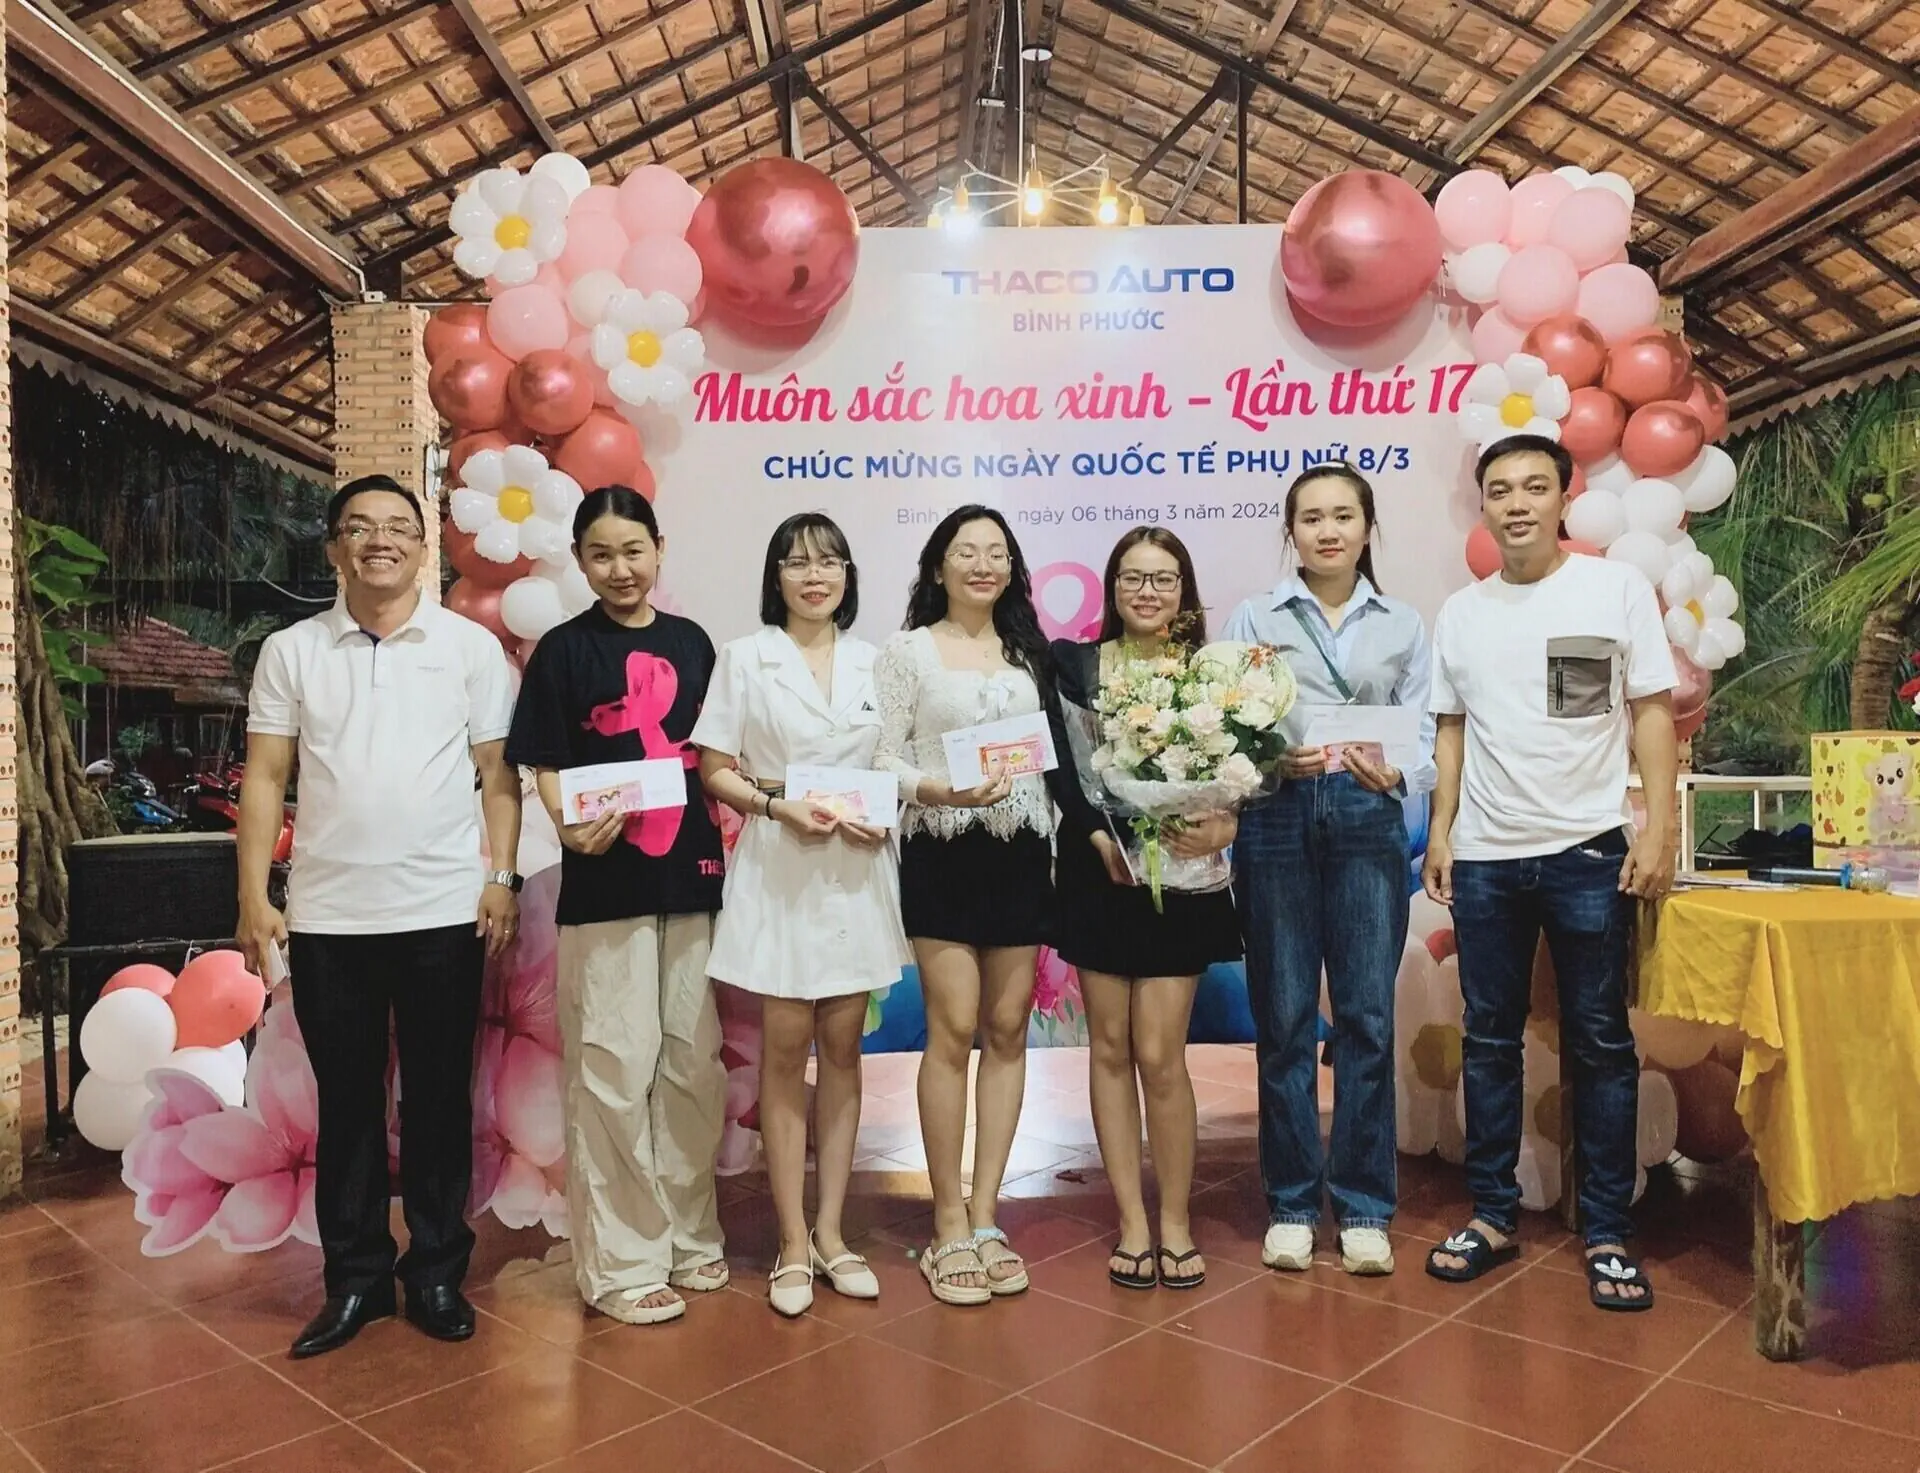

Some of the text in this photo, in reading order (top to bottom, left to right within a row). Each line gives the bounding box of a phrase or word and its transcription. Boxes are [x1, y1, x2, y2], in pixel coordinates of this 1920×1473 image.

[941, 263, 1235, 295] THACO AUTO
[1013, 307, 1165, 333] BÌNH PHƯỚC
[693, 371, 837, 423] Muôn
[847, 361, 934, 422] sắc
[944, 372, 1043, 422] hoa
[1055, 371, 1172, 421] xinh
[1225, 358, 1319, 433] Lần
[1328, 364, 1416, 416] thứ
[1428, 363, 1478, 415] 17
[764, 449, 854, 480] CHÚC
[865, 448, 963, 479] MỪNG
[974, 448, 1061, 478] NGÀY
[1072, 441, 1167, 476] QUỐC
[1177, 440, 1217, 475] TẾ
[1226, 448, 1290, 478] PHỤ
[1359, 444, 1410, 475] 8/3
[1018, 505, 1066, 526] ngày
[1071, 505, 1097, 522] 06
[1104, 504, 1160, 524] tháng
[1166, 503, 1178, 521] 3
[1184, 503, 1226, 520] năm
[1231, 501, 1281, 519] 2024
